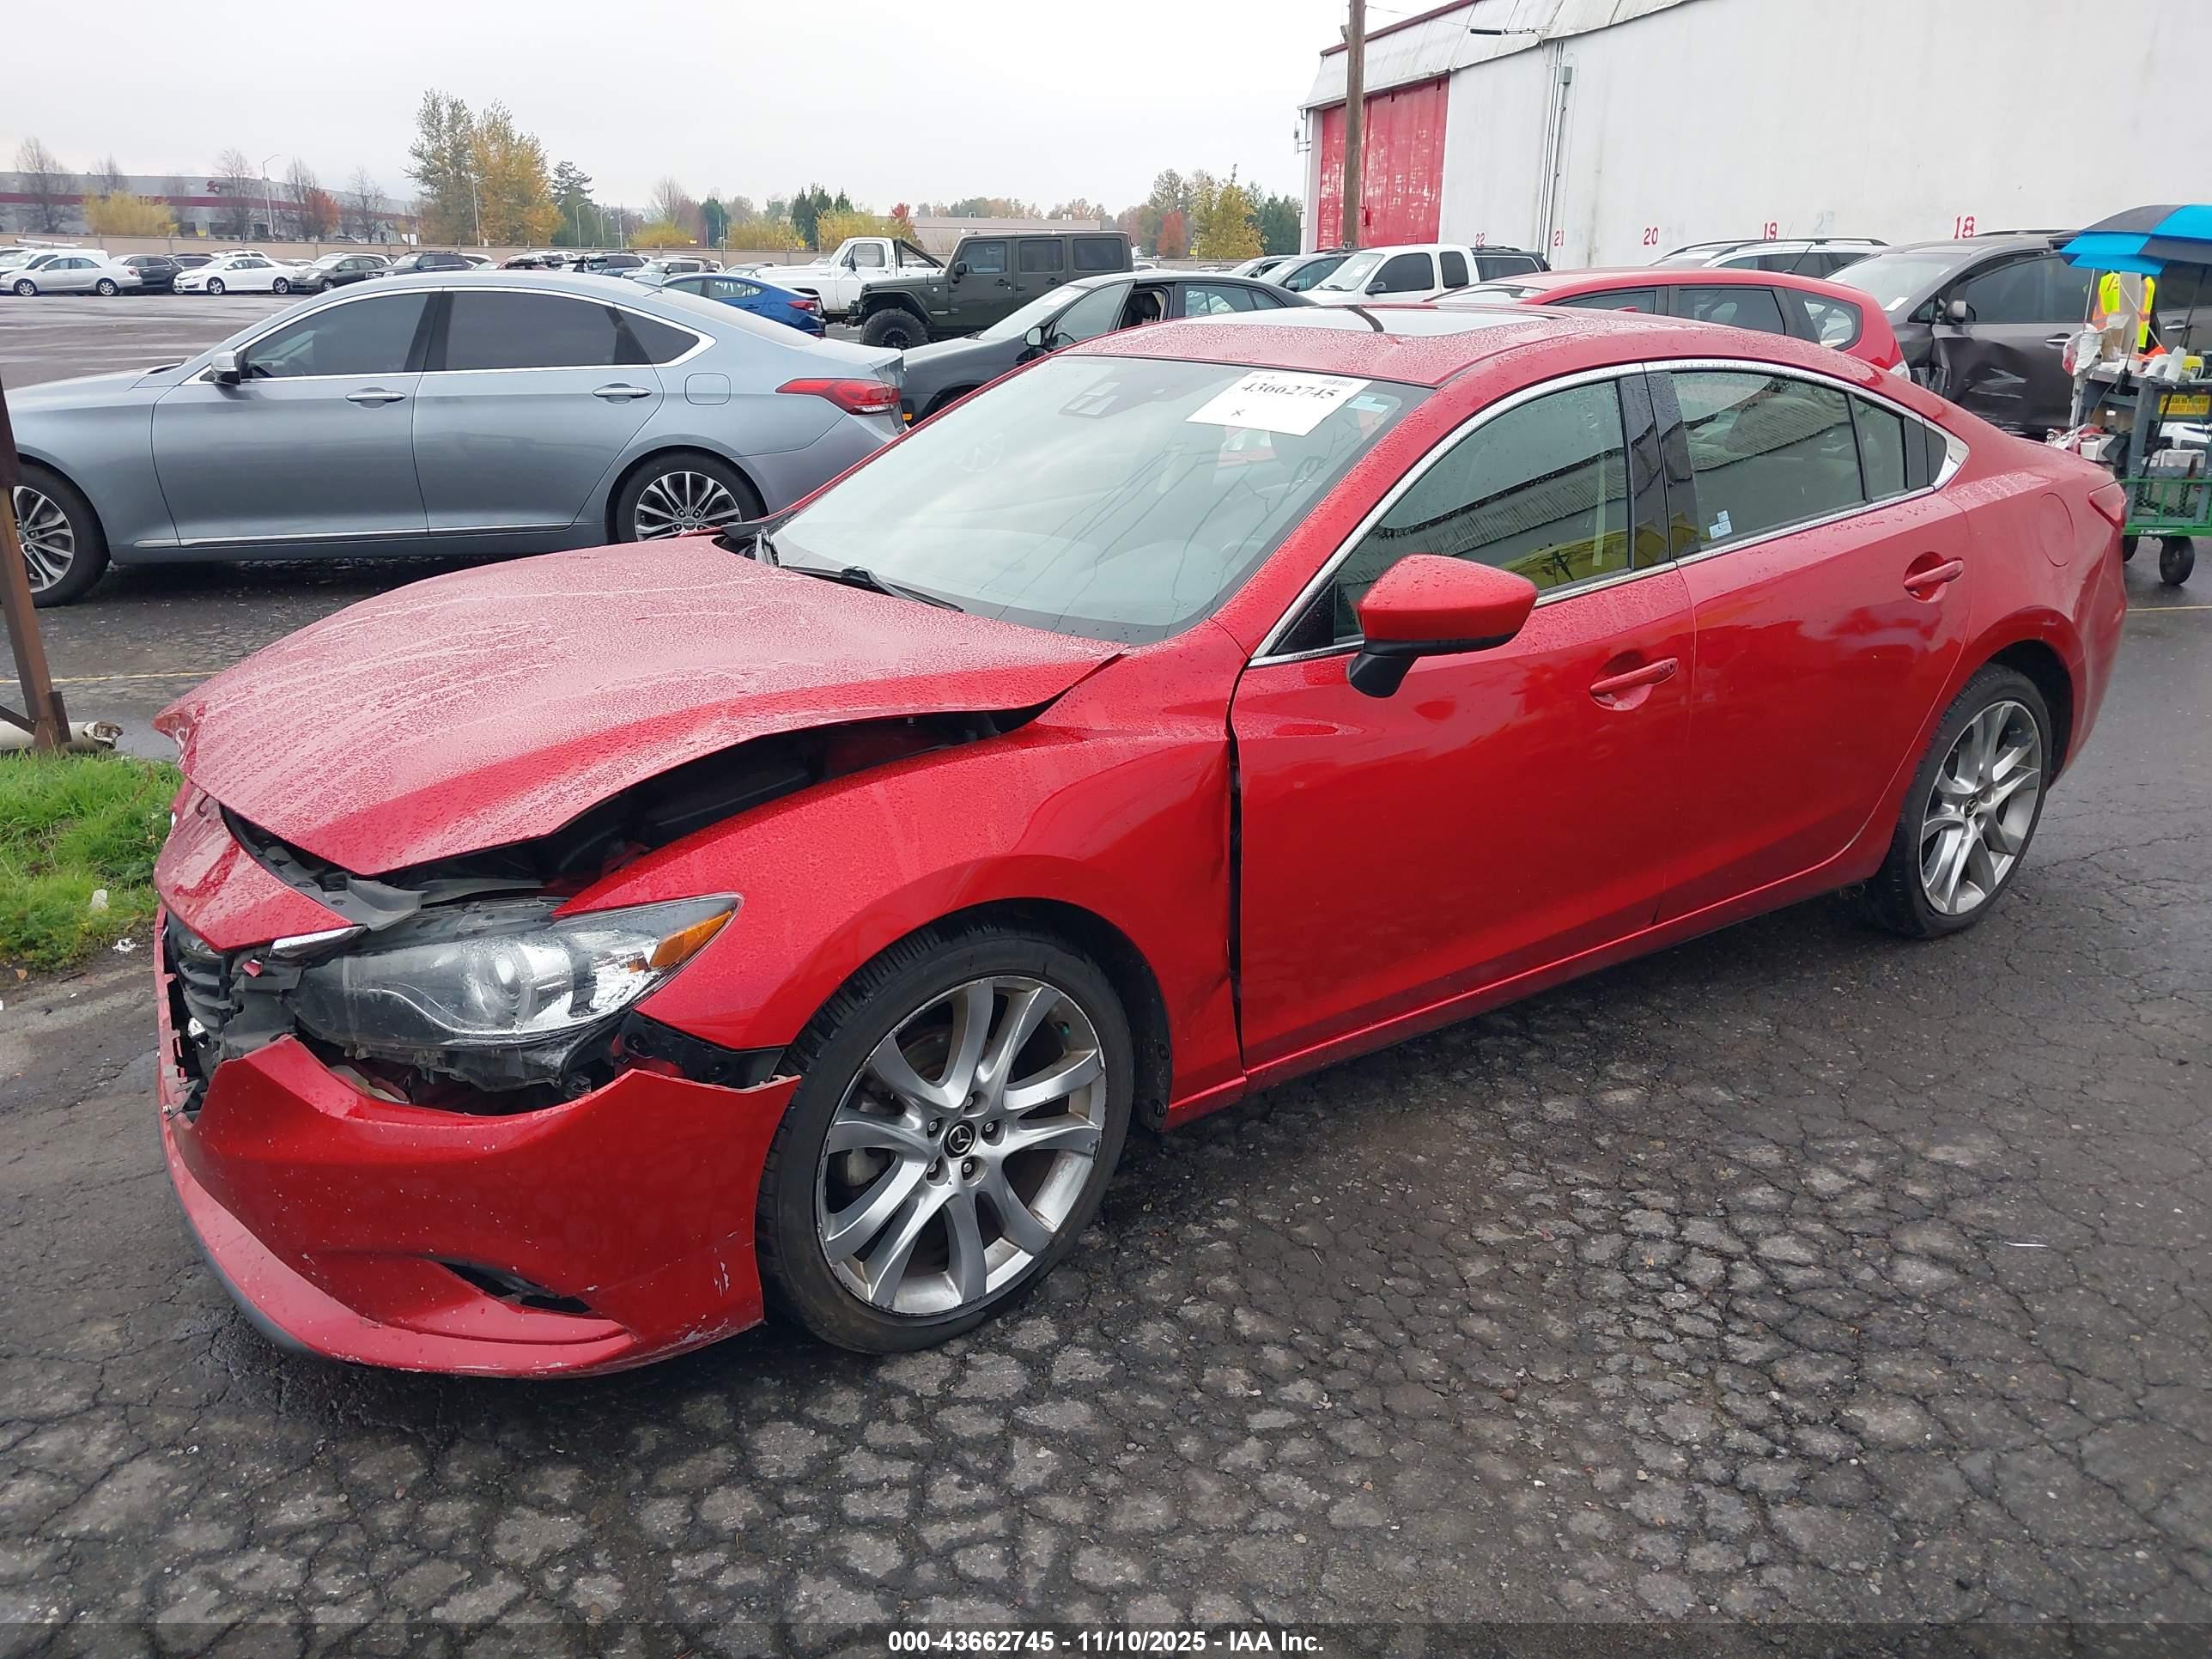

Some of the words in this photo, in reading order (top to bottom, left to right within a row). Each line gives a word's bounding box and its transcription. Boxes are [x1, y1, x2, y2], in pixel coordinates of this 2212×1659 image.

[1764, 222, 1778, 240] 19
[1954, 216, 1975, 239] 18
[1475, 233, 1486, 248] 22
[1553, 230, 1565, 246] 21
[1644, 227, 1659, 246] 20
[1242, 382, 1340, 399] 43662745
